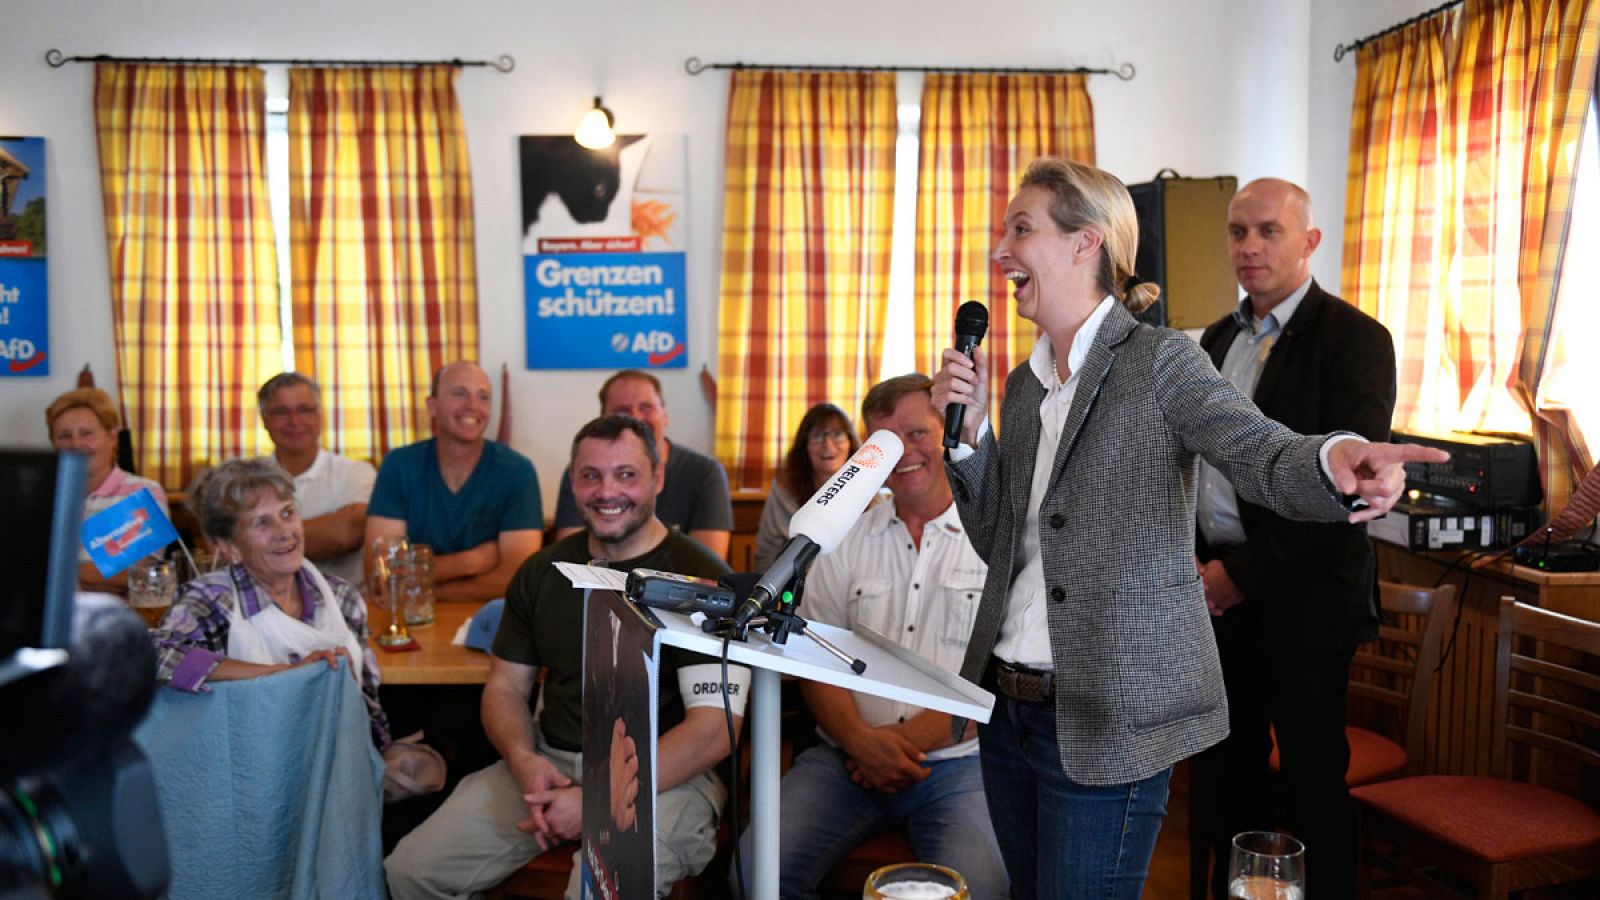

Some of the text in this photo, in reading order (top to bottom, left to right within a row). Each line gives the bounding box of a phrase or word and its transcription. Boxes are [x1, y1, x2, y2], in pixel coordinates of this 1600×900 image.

[535, 259, 663, 288] Grenzen
[537, 287, 675, 317] schützen!
[631, 330, 675, 353] AfD
[816, 464, 860, 506] REUTERS
